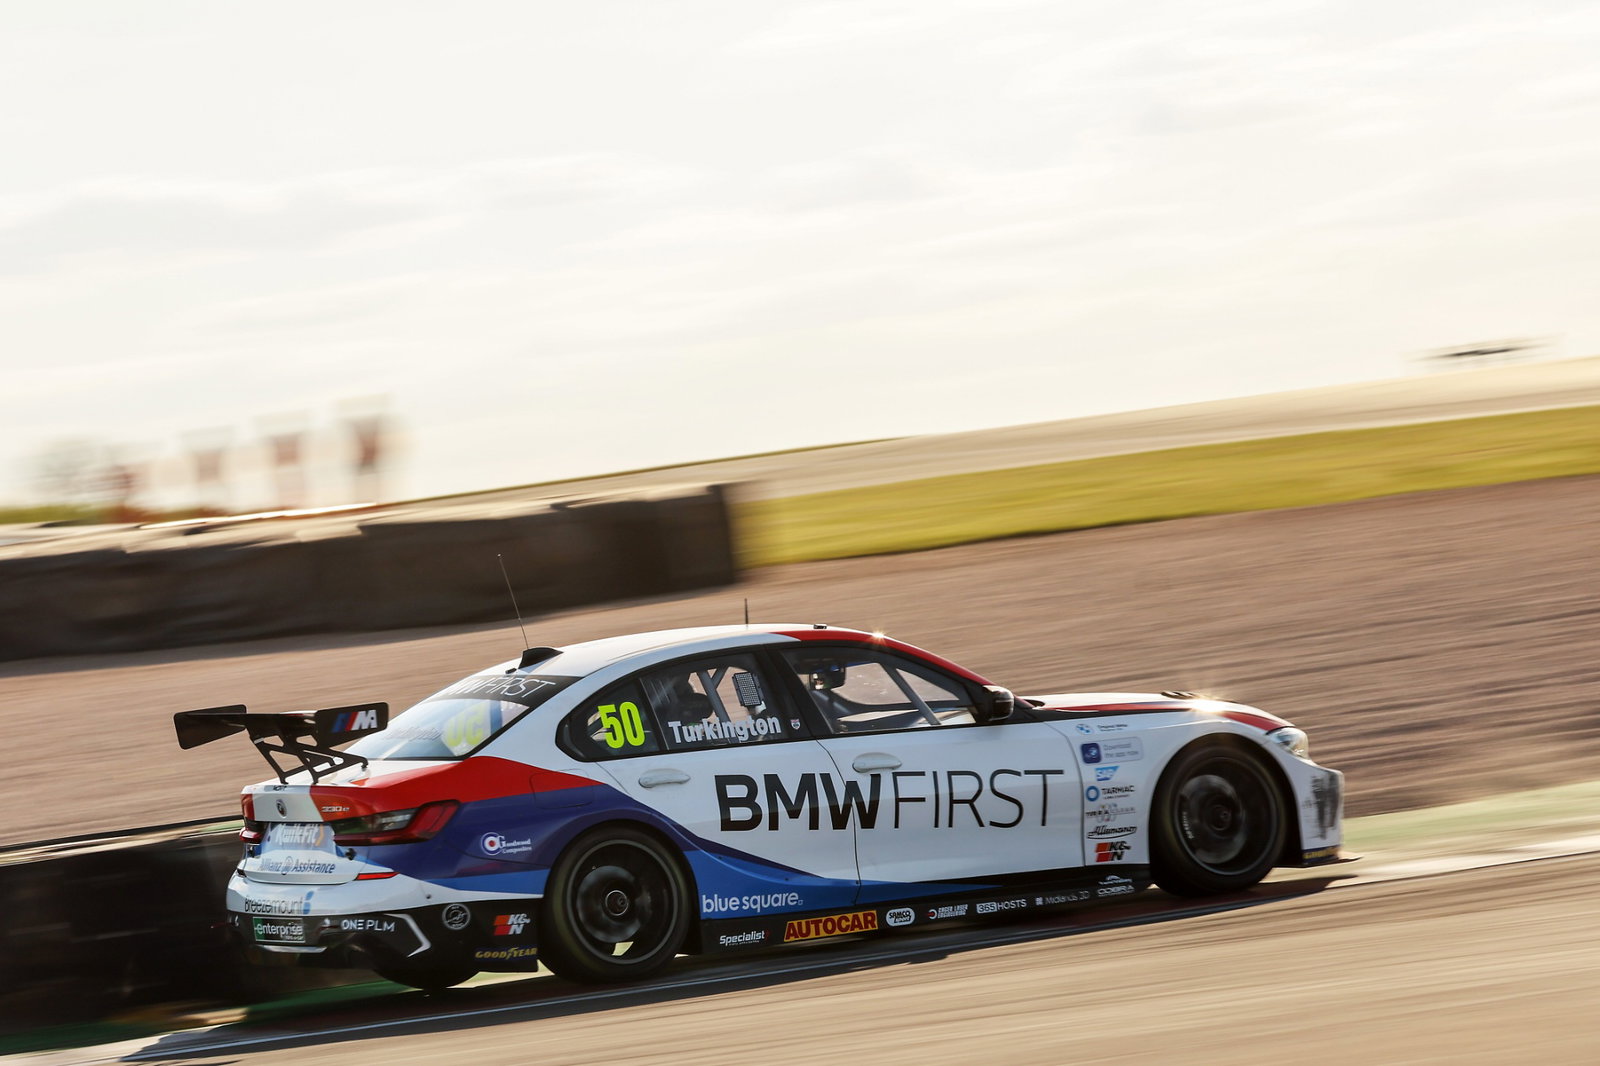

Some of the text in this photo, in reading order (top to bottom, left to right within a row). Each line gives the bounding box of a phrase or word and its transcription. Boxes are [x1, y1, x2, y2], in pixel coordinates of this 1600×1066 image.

[597, 701, 646, 749] 50
[667, 715, 782, 744] Turkington
[1101, 785, 1135, 795] TARMAC
[291, 858, 335, 874] Assistance
[702, 892, 799, 913] blue square
[256, 922, 303, 935] enterprise
[784, 911, 877, 941] AUTOCAR
[719, 930, 766, 947] Specialist
[475, 947, 538, 960] GOODYEAR
